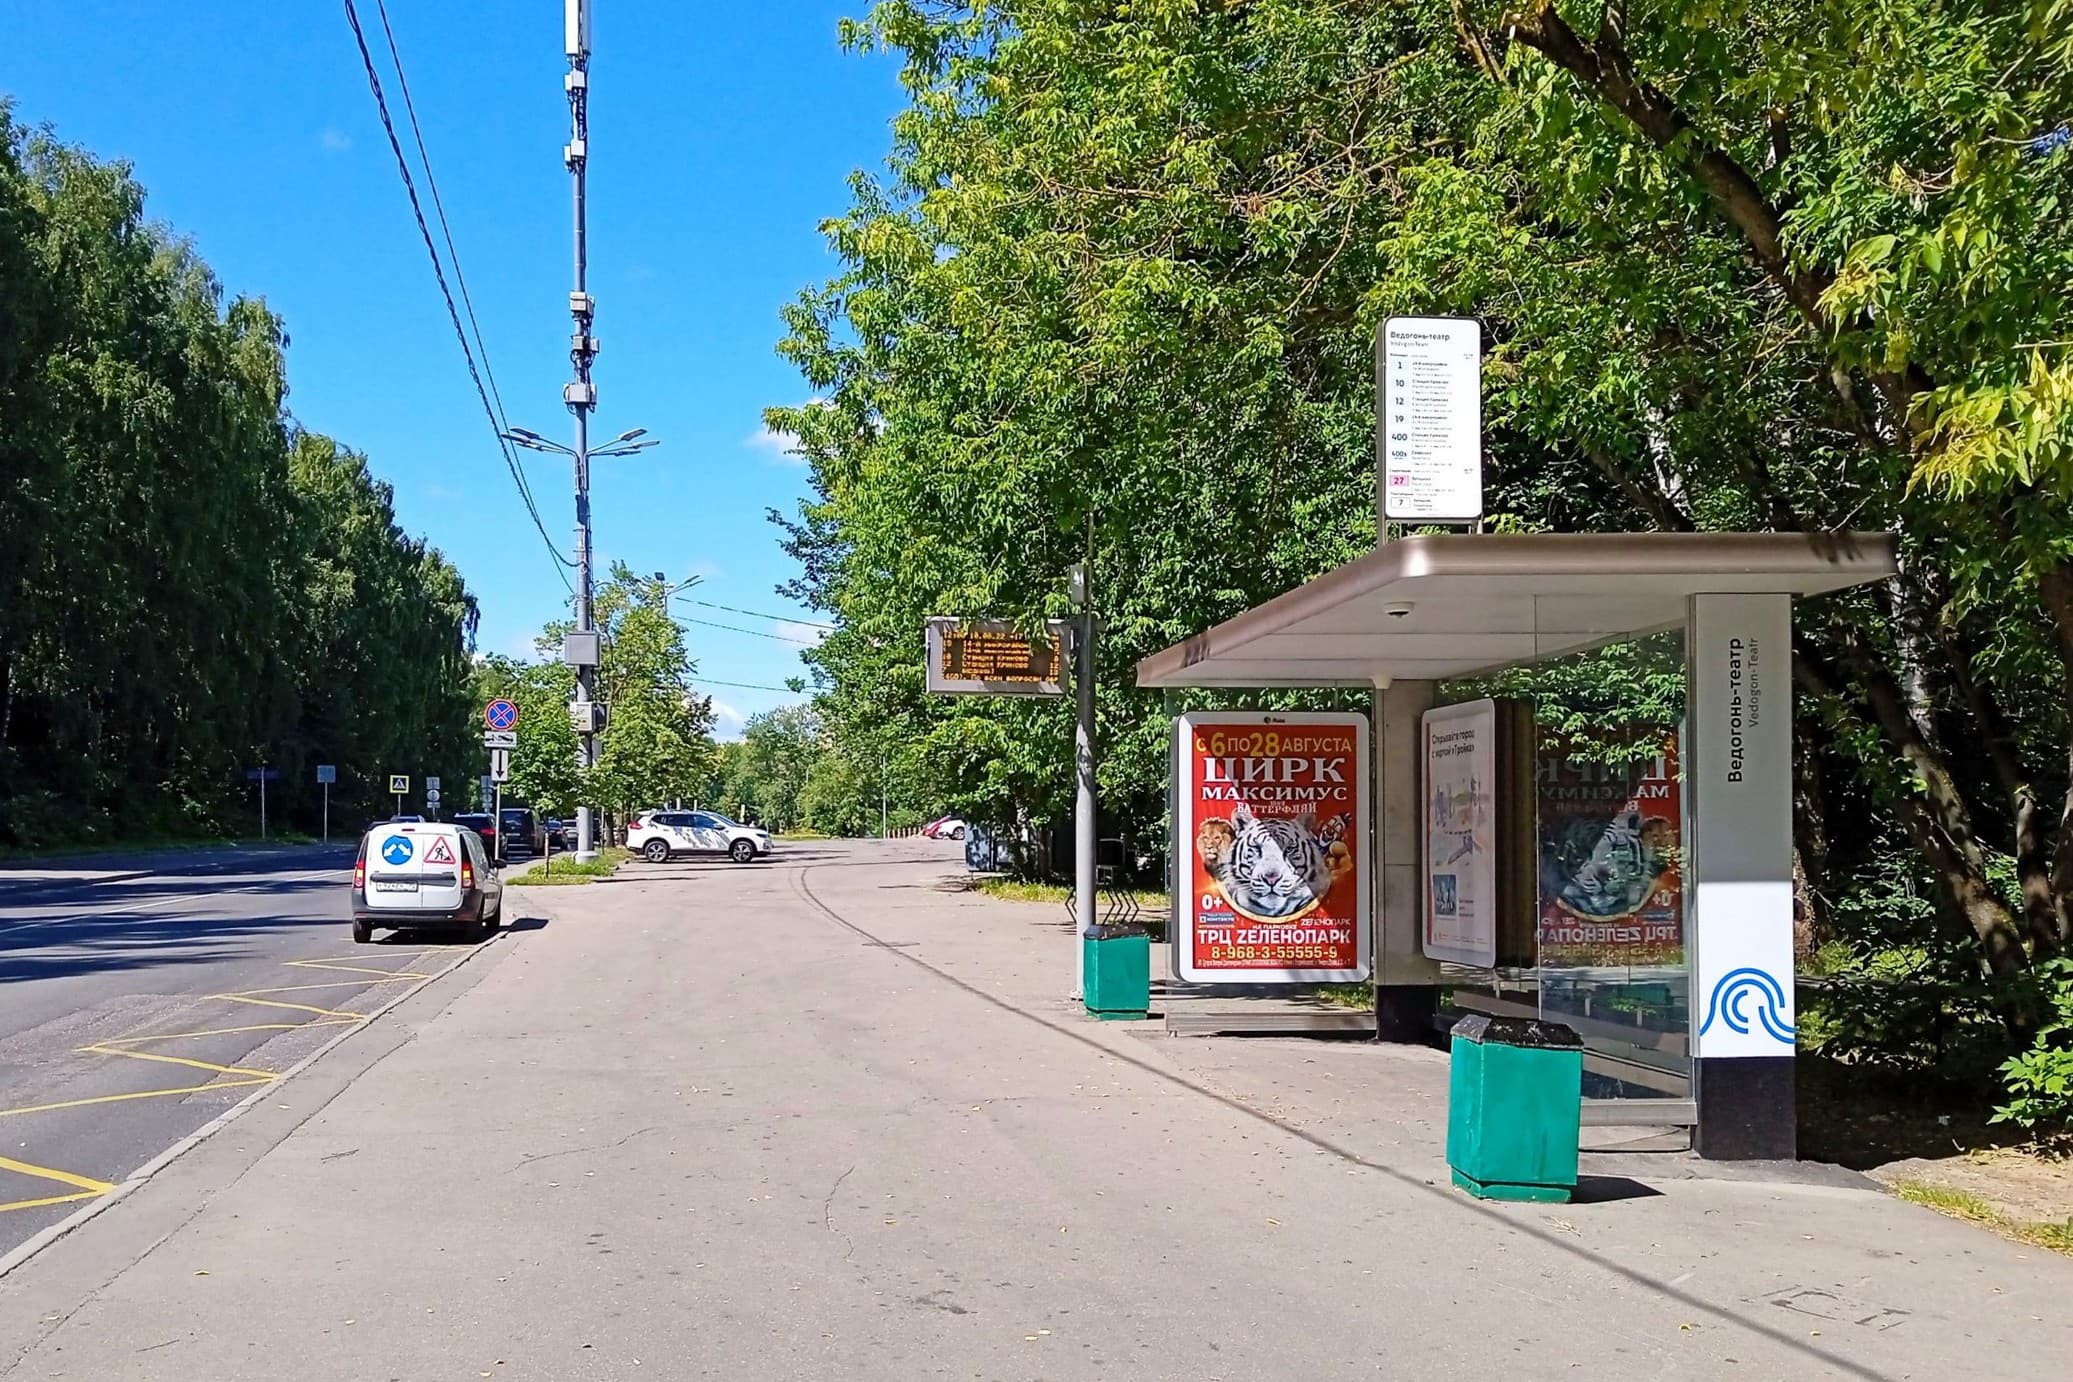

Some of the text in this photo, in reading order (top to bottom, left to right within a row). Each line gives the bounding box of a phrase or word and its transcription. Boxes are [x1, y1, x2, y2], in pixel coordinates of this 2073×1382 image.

[1390, 331, 1450, 342] Ведогонь-театр
[1397, 361, 1403, 369] 1
[1395, 379, 1405, 388] 10
[1395, 397, 1405, 405] 12
[1395, 415, 1405, 423] 19
[1391, 433, 1408, 441] 400
[1393, 476, 1405, 485] 27
[1748, 638, 1761, 728] Vedogon-Teatr
[1727, 638, 1744, 782] Ведогонь-театр
[1210, 732, 1226, 757] 6
[1227, 738, 1250, 752] ПО
[1250, 732, 1280, 757] 28
[1282, 738, 1352, 752] АВГУСТА
[1203, 757, 1346, 787] ЦИРК
[1201, 786, 1348, 801] МАКСИМУС
[1236, 801, 1317, 814] БАТТЕРФЛЯЙ
[1201, 894, 1223, 910] 0+
[1197, 929, 1231, 946] ТРЦ
[1211, 946, 1338, 959] 8-968-3-55555-9
